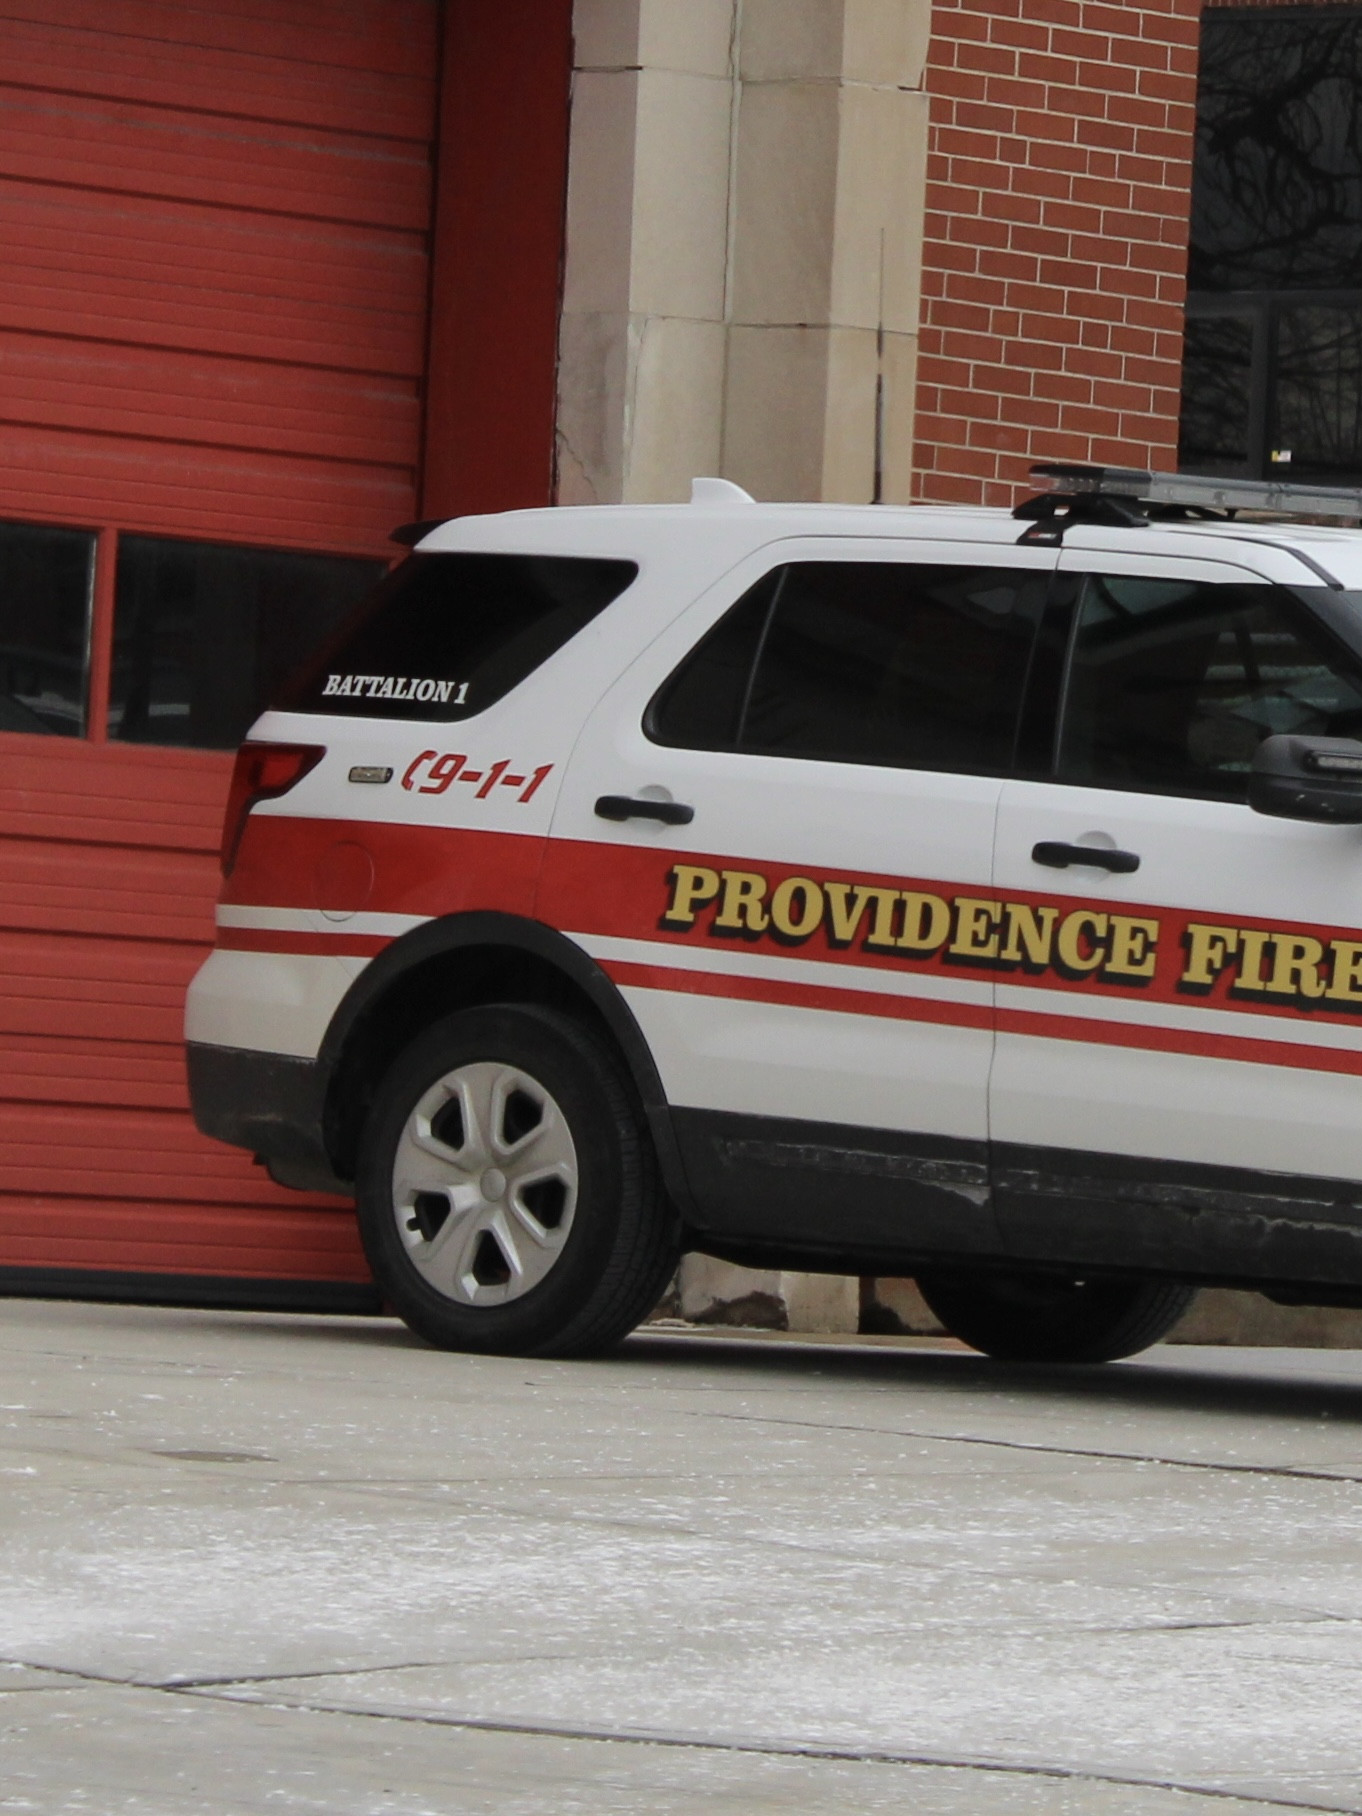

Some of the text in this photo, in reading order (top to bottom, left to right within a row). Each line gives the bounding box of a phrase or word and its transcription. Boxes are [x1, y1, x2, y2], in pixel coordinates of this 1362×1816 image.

[321, 674, 471, 705] BATTALION 1
[418, 752, 555, 804] 9-1-1
[659, 864, 1160, 987] PROVIDENCE
